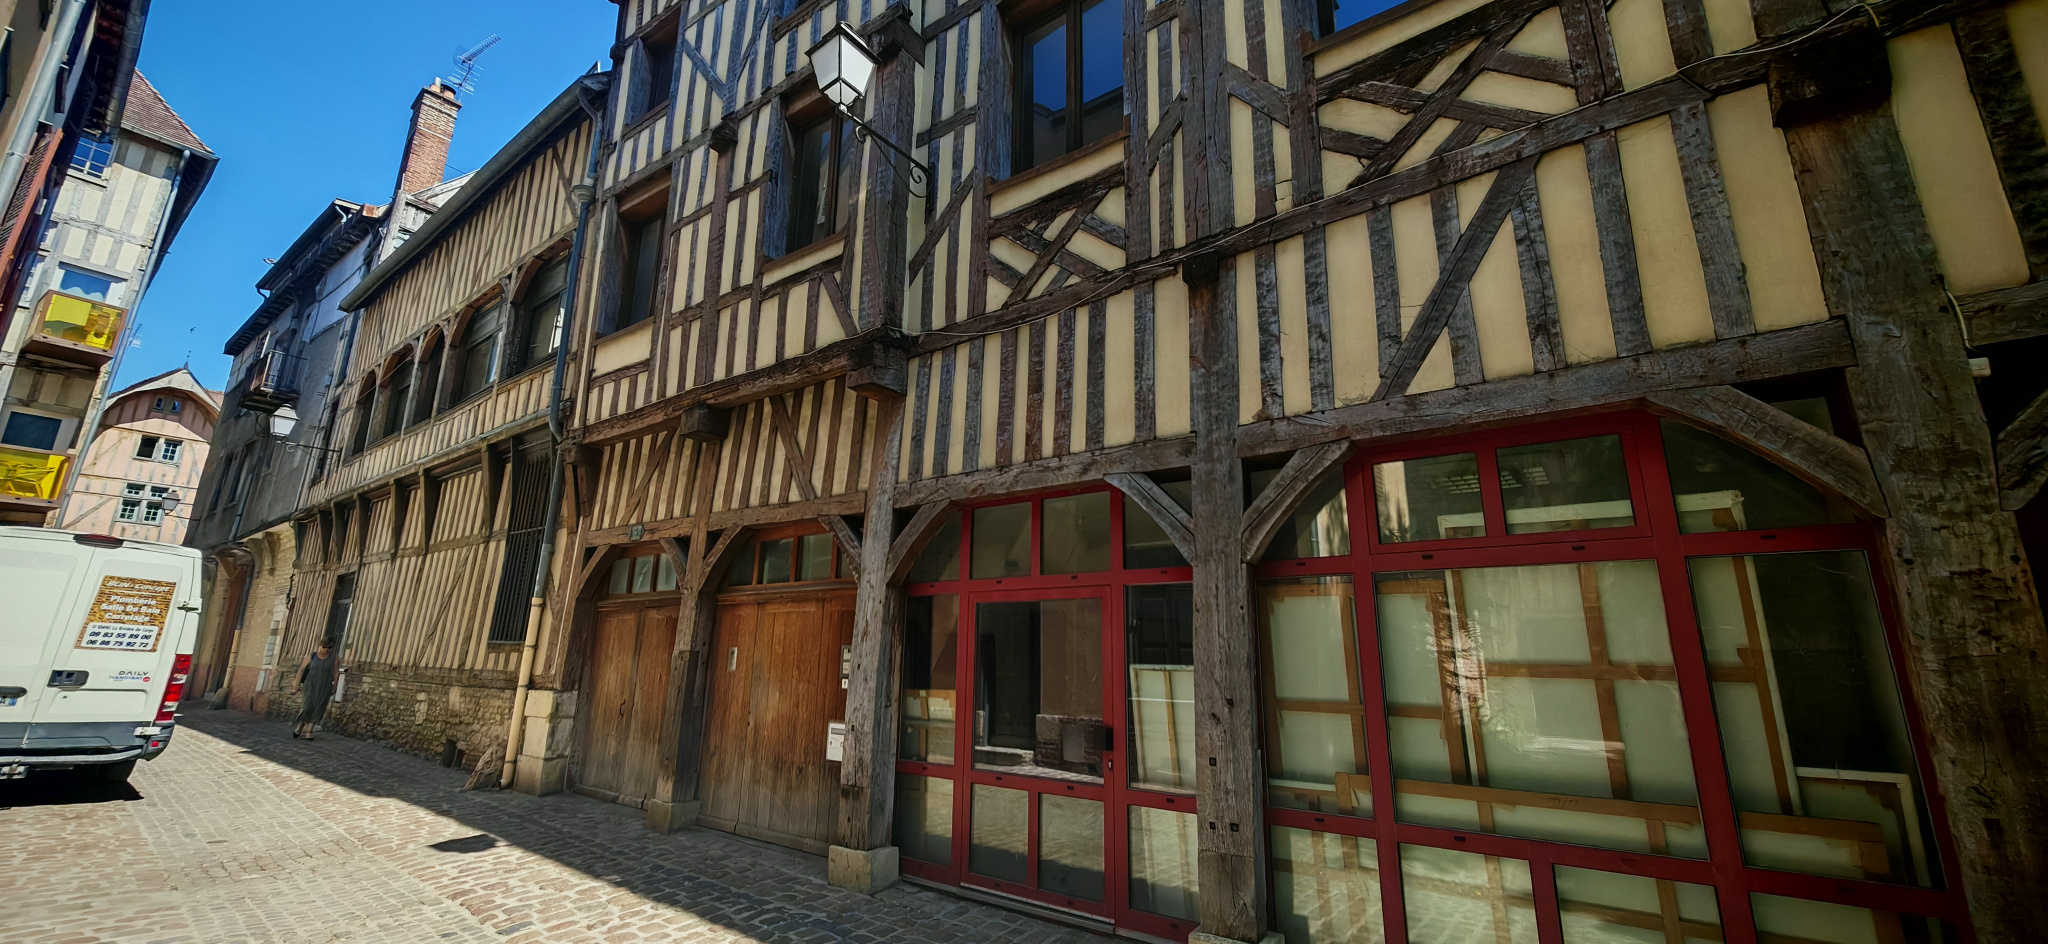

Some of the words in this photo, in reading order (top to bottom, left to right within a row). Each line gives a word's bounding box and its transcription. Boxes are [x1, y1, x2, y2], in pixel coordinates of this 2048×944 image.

[110, 595, 157, 605] Plomberie
[101, 603, 124, 611] Salle
[141, 606, 160, 614] Bain
[105, 612, 150, 622] Carrelage
